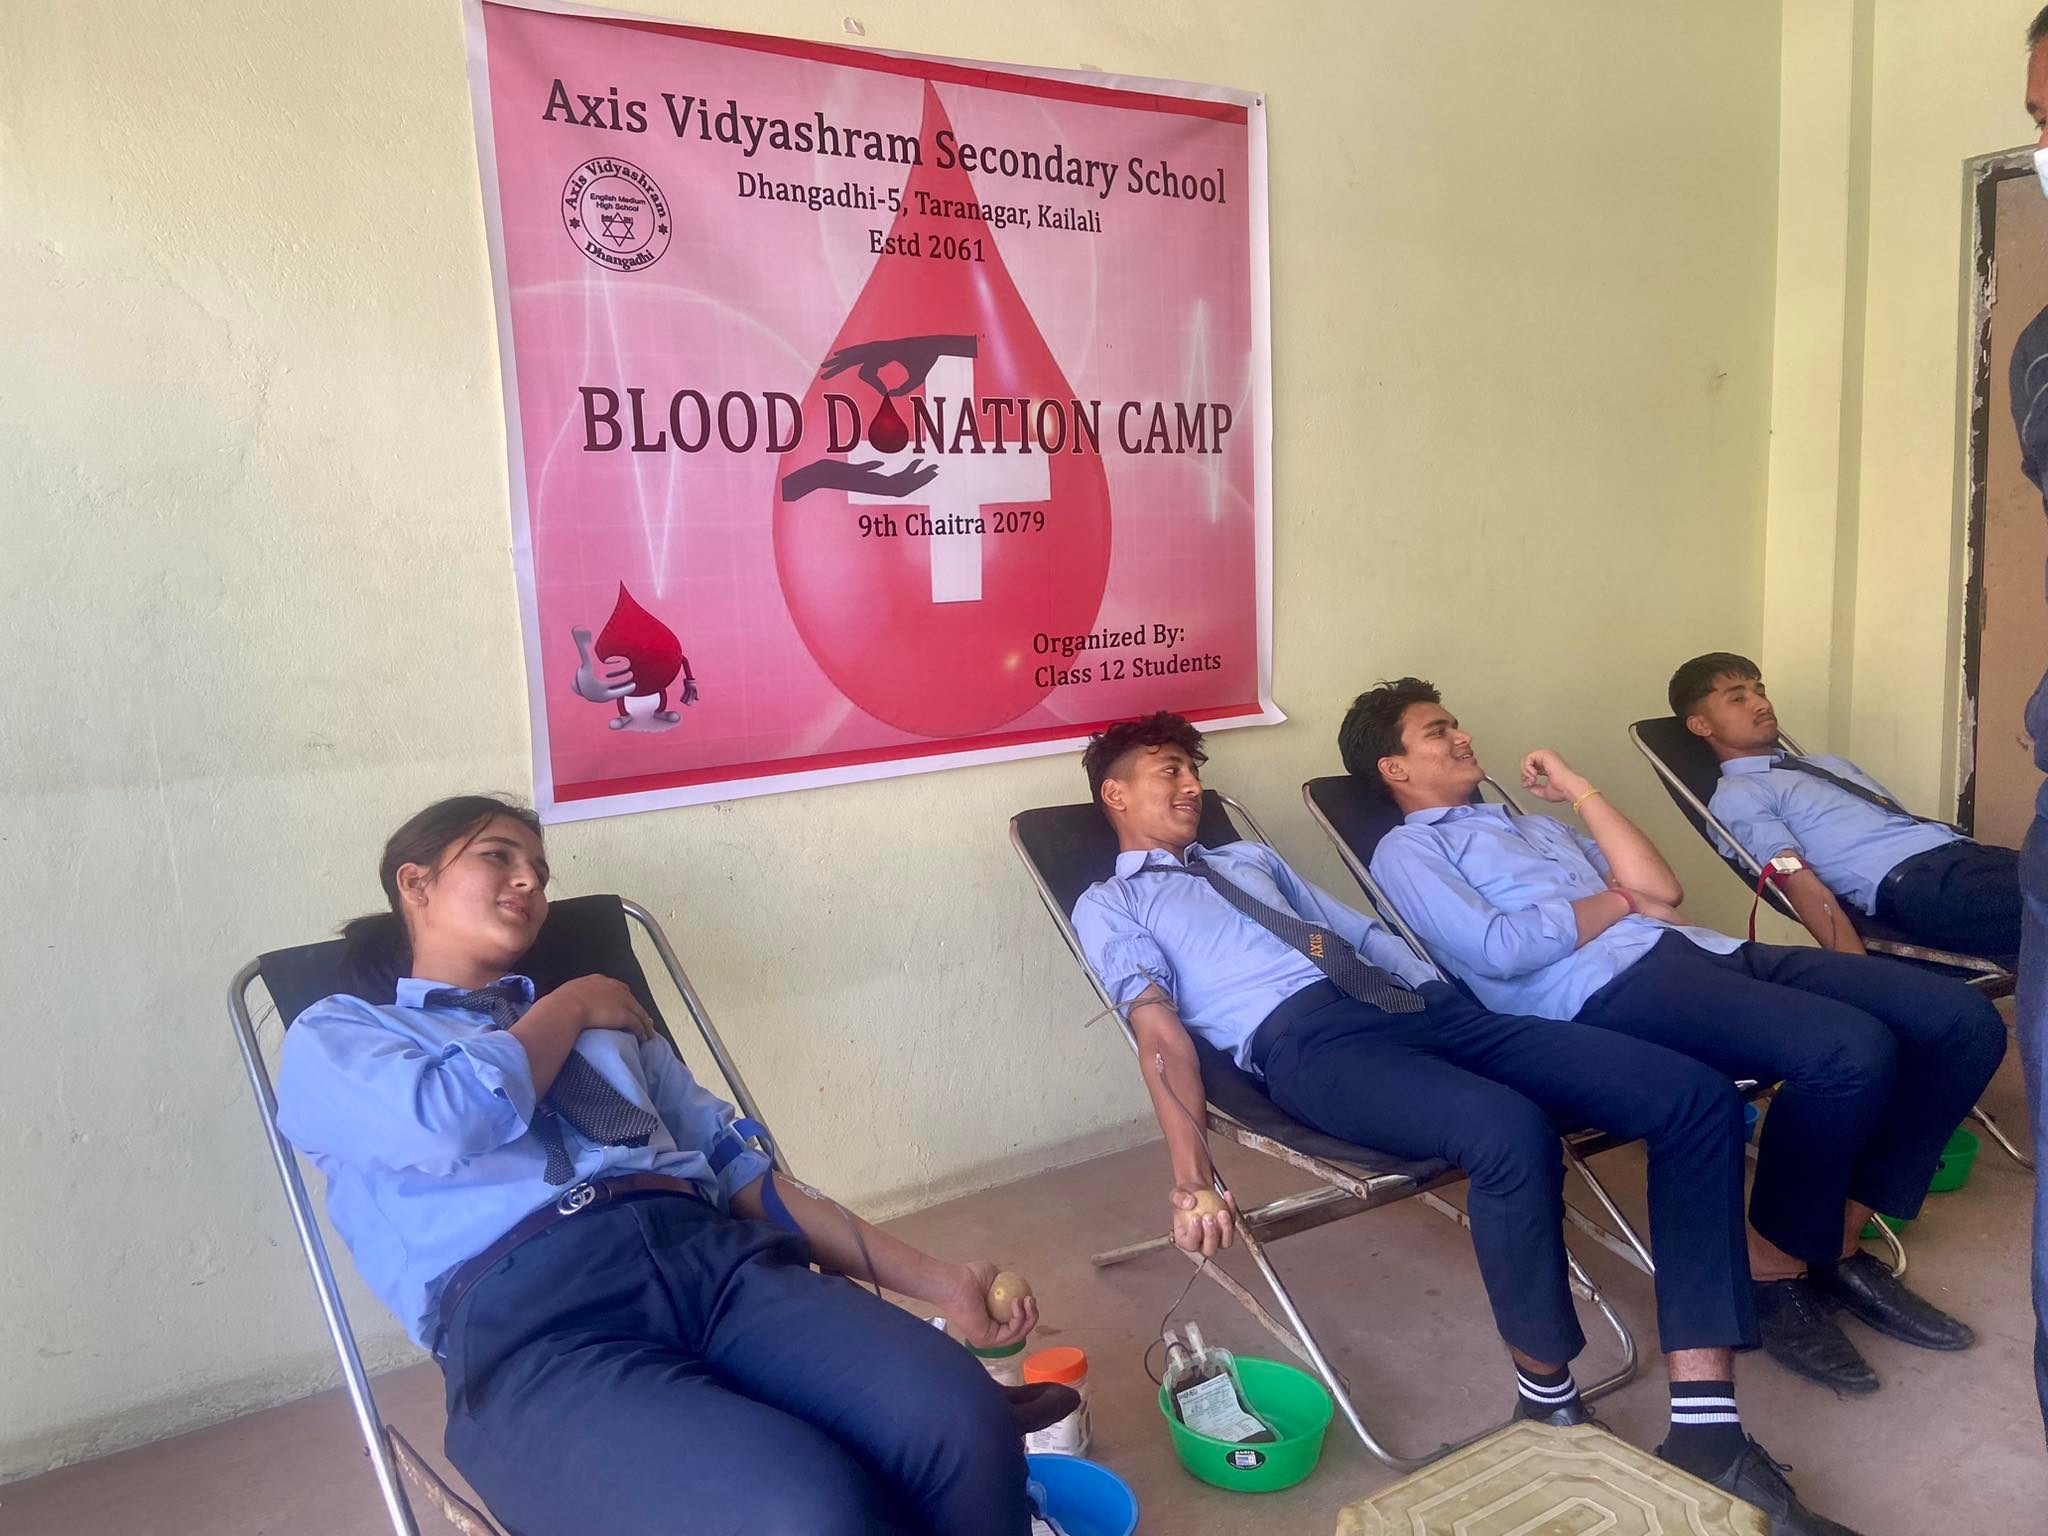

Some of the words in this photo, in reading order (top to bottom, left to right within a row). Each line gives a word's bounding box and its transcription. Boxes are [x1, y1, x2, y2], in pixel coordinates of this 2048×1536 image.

[542, 78, 649, 133] Axis
[661, 92, 923, 166] Vidyashram
[936, 130, 1119, 199] Secondary
[1127, 157, 1227, 204] School
[565, 175, 588, 211] Axis
[585, 160, 666, 218] Vidyashram
[590, 193, 617, 203] English
[618, 195, 646, 205] Medium
[596, 201, 613, 210] High
[615, 203, 639, 211] School
[737, 171, 908, 217] Dhangadhi-5,
[914, 191, 1031, 229] Taranagar,
[1037, 204, 1102, 233] Kailali
[584, 241, 655, 270] Dhangadhi
[869, 229, 922, 257] Estd
[928, 234, 986, 263] 2061
[578, 386, 803, 453] BLOOD
[1118, 401, 1233, 454] CAMP
[858, 514, 898, 538] 9th
[905, 513, 986, 536] Chaitra
[993, 511, 1045, 533] 2079
[1033, 625, 1146, 658] Organized
[1153, 623, 1185, 648] By:
[1034, 665, 1092, 688] Class
[1099, 660, 1125, 682] 12
[1133, 653, 1222, 678] Students
[1309, 933, 1324, 958] AXIS
